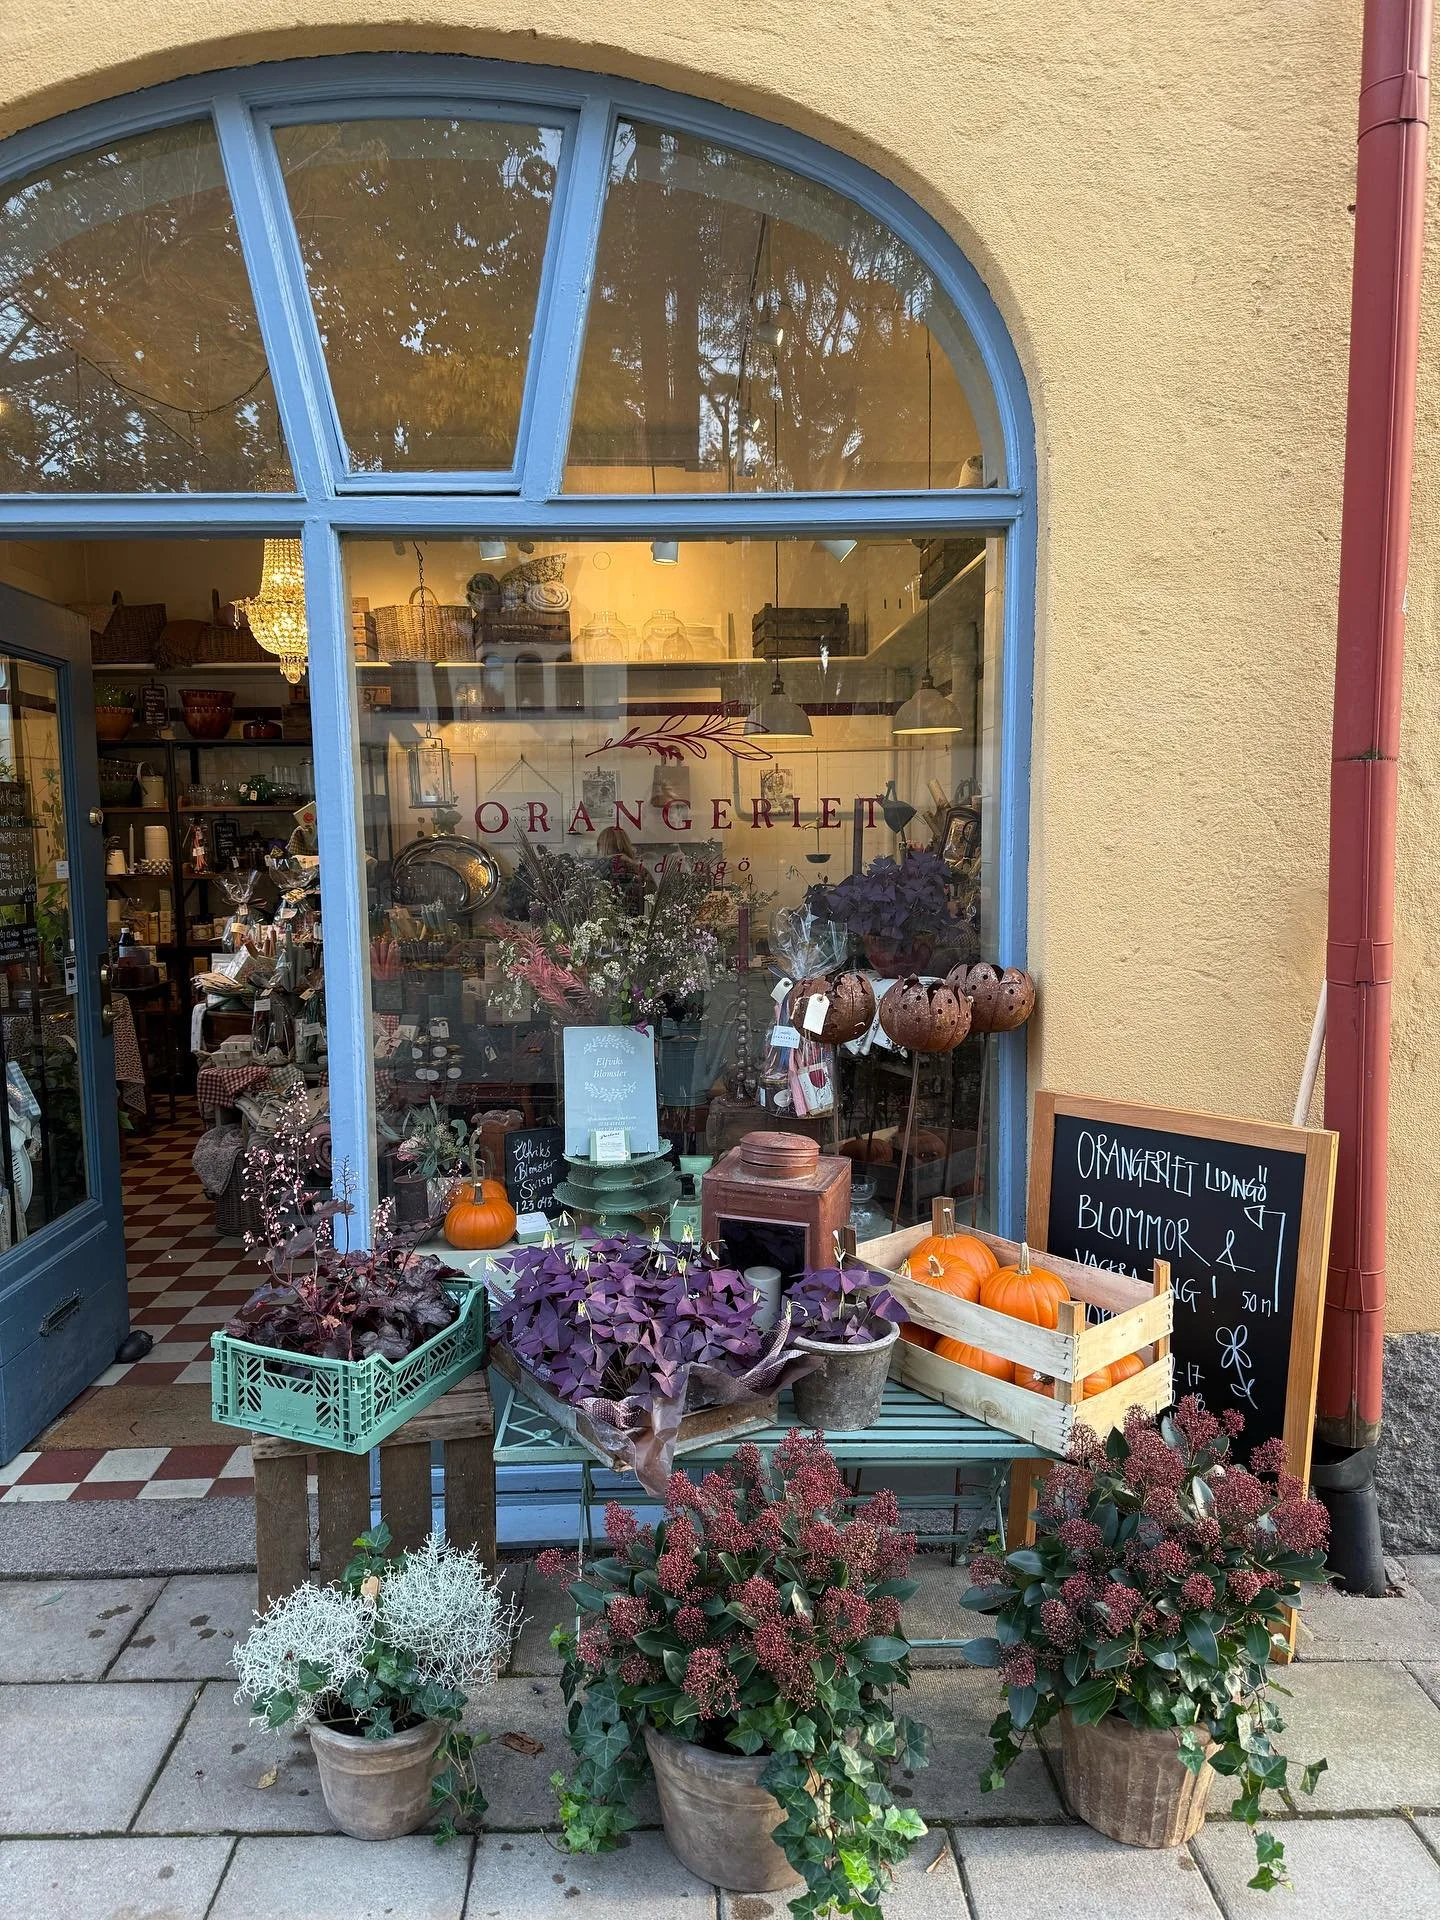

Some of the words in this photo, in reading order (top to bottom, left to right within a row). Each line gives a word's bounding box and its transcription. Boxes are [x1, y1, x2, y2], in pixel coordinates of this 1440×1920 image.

[474, 796, 883, 834] ORANGERIET
[611, 854, 751, 881] Lidingö
[593, 1069, 627, 1078] Blomster
[514, 1159, 558, 1183] Blomster
[1077, 1130, 1199, 1197] ORANGERIET
[1204, 1162, 1268, 1203] LIDINGÖ
[515, 1200, 535, 1215] 123
[1077, 1194, 1211, 1267] BLOMMOR
[1215, 1229, 1256, 1273] &
[1241, 1290, 1257, 1314] 50
